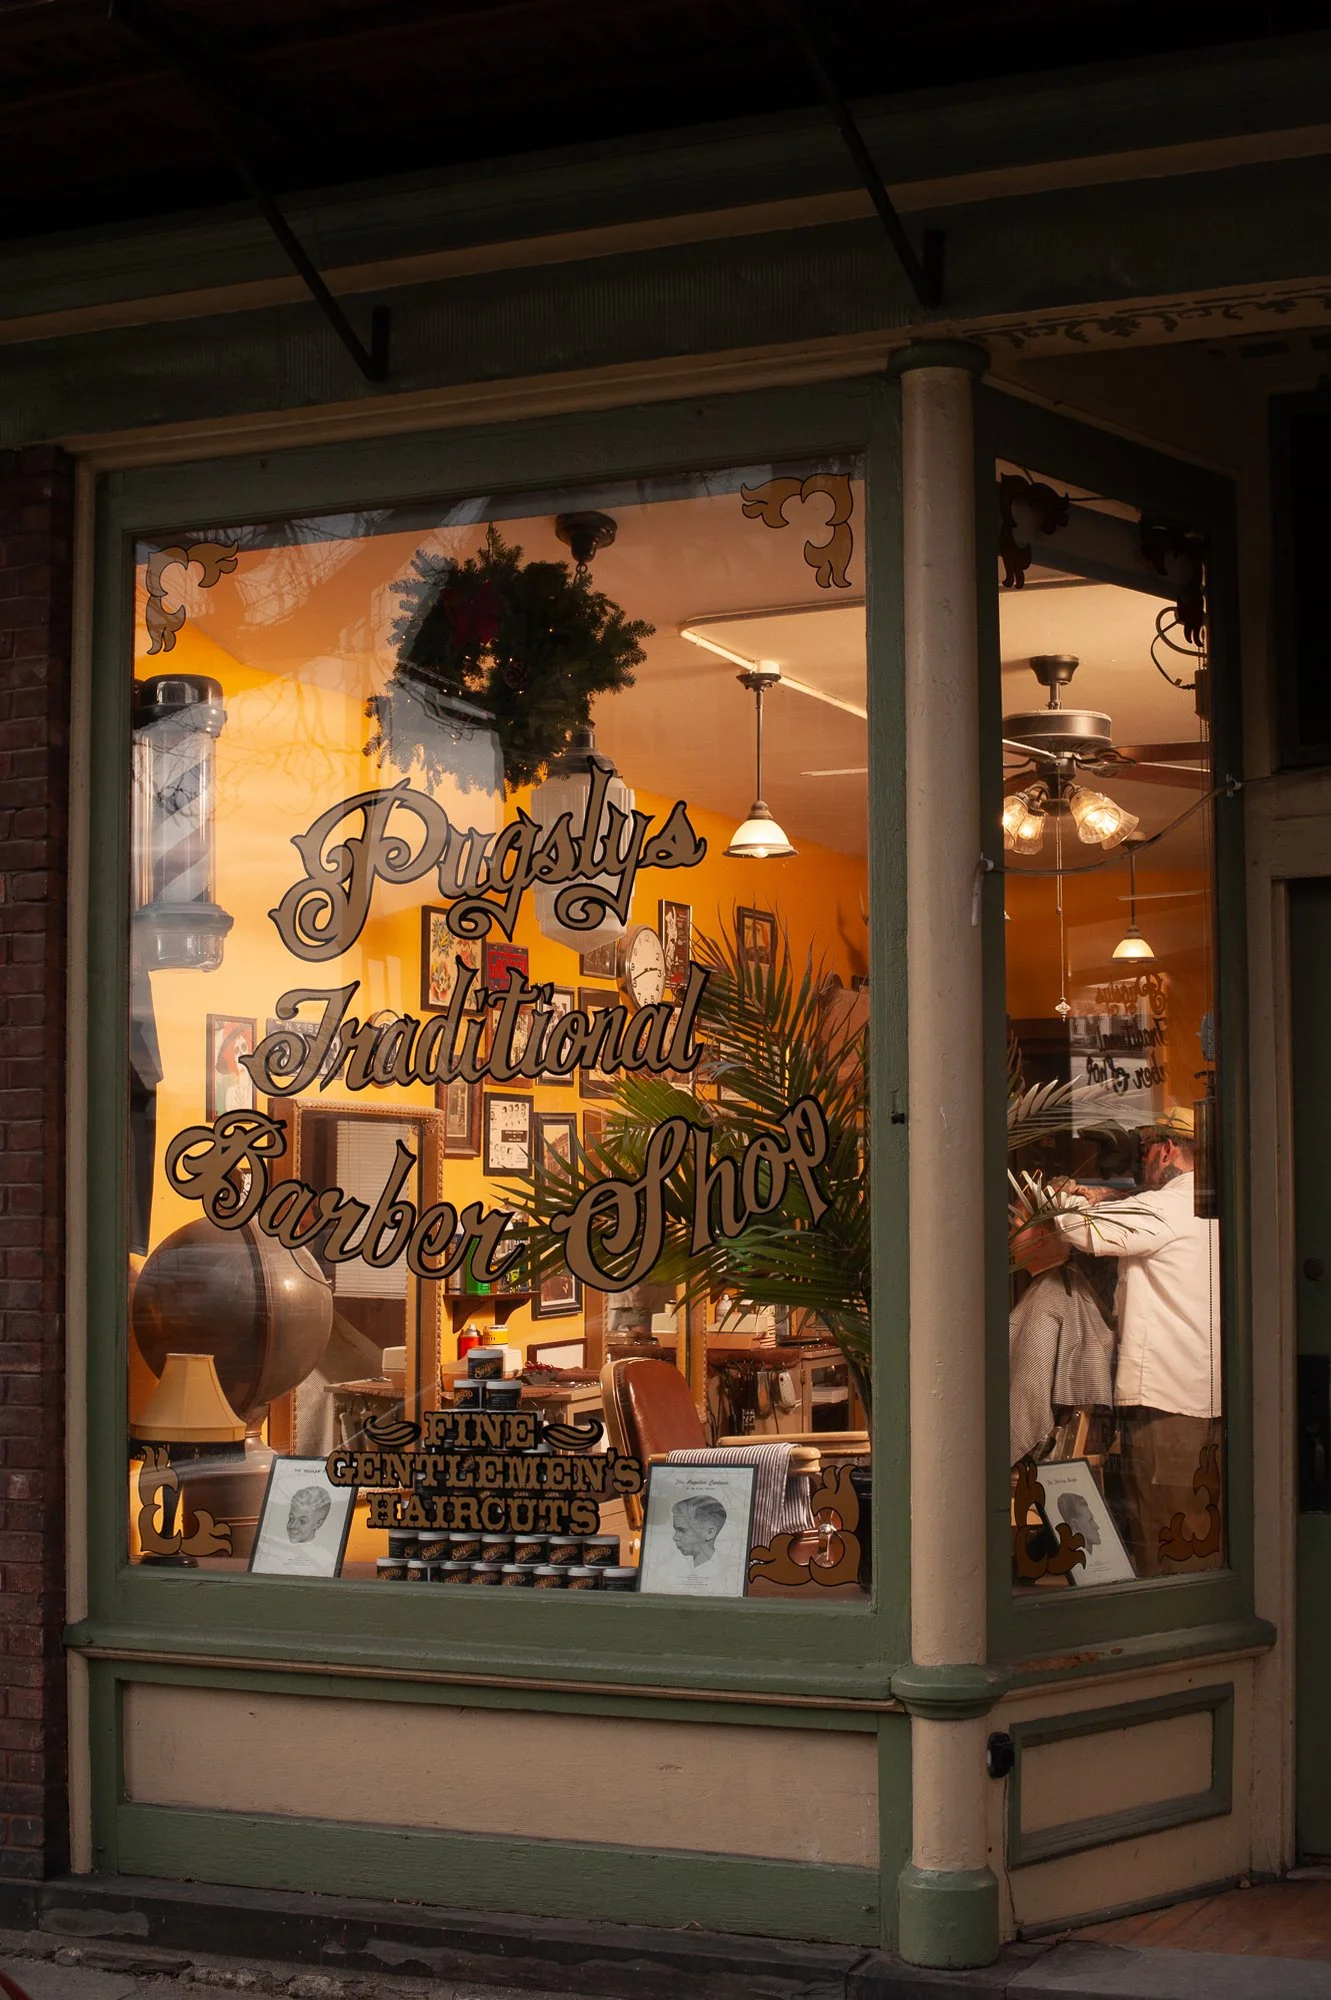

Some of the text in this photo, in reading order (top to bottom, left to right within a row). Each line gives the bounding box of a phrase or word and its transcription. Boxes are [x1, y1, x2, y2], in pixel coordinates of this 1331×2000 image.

[268, 756, 707, 963] Pugslys
[240, 957, 715, 1098] Traditional
[165, 1095, 831, 1293] Barber Shop
[325, 1446, 646, 1494] GENTLEMEN'S
[422, 1411, 543, 1451] FINE
[367, 1491, 600, 1536] HAIRCUTS
